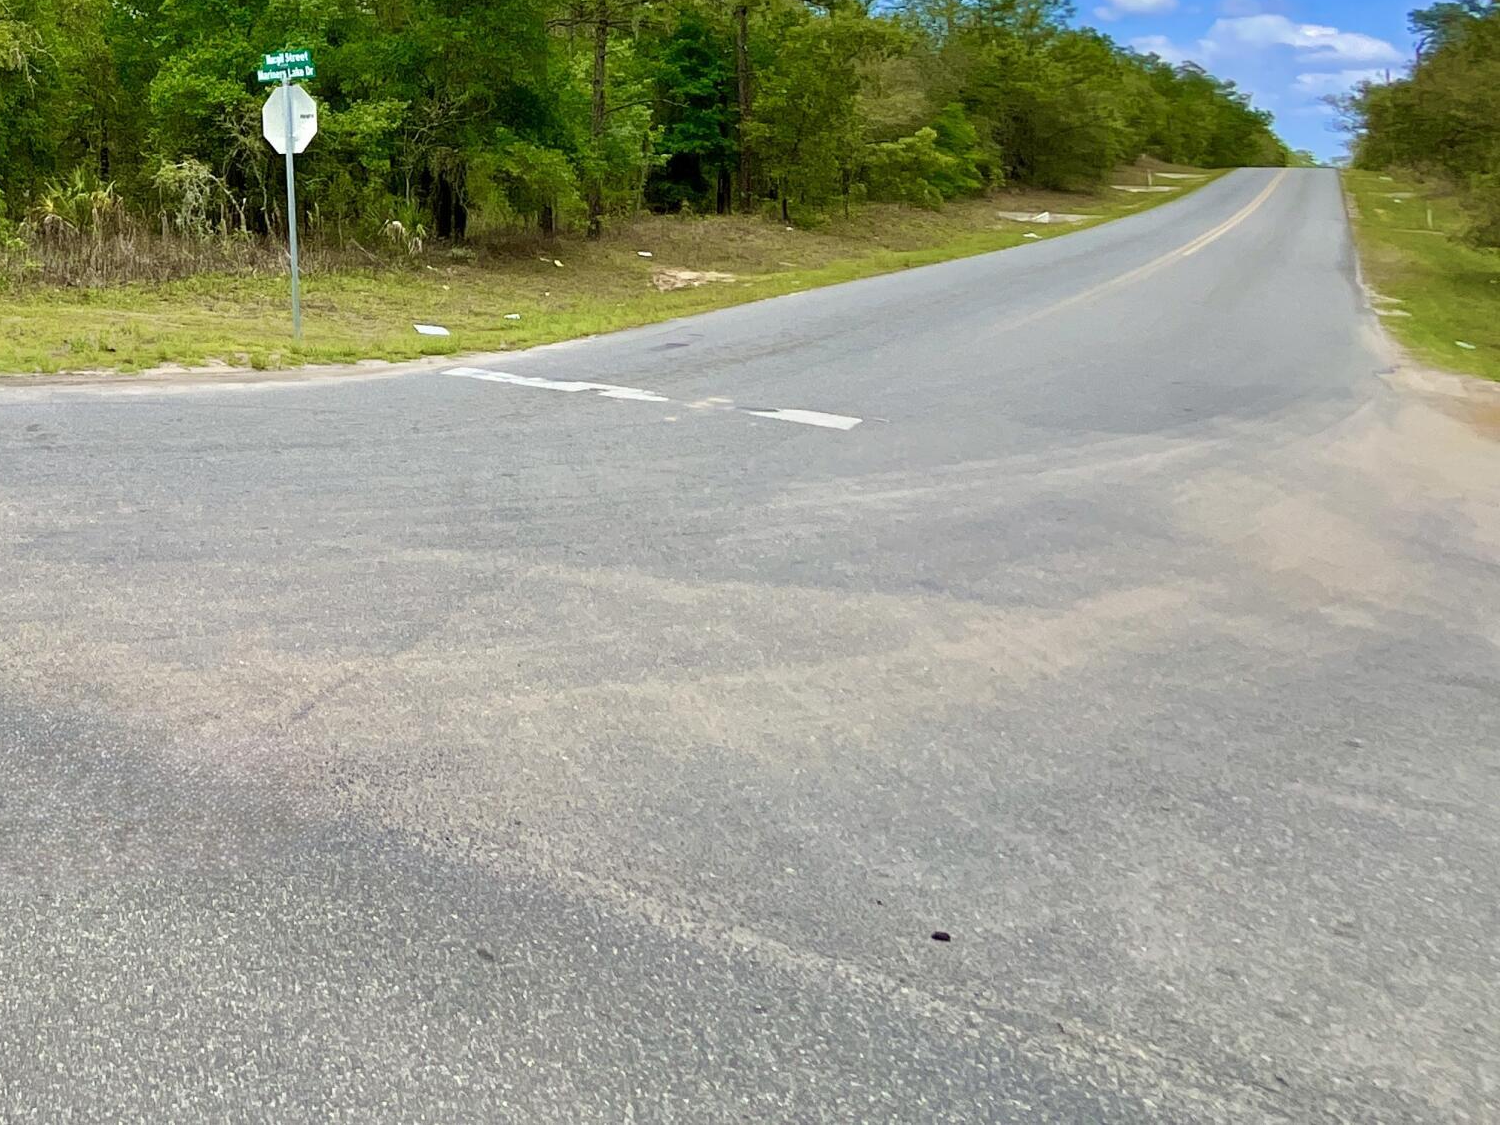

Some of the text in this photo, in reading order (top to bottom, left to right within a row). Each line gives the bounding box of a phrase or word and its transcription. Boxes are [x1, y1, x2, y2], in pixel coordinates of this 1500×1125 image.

[285, 51, 308, 62] Street
[288, 67, 304, 78] Lake
[305, 66, 314, 75] Dr
